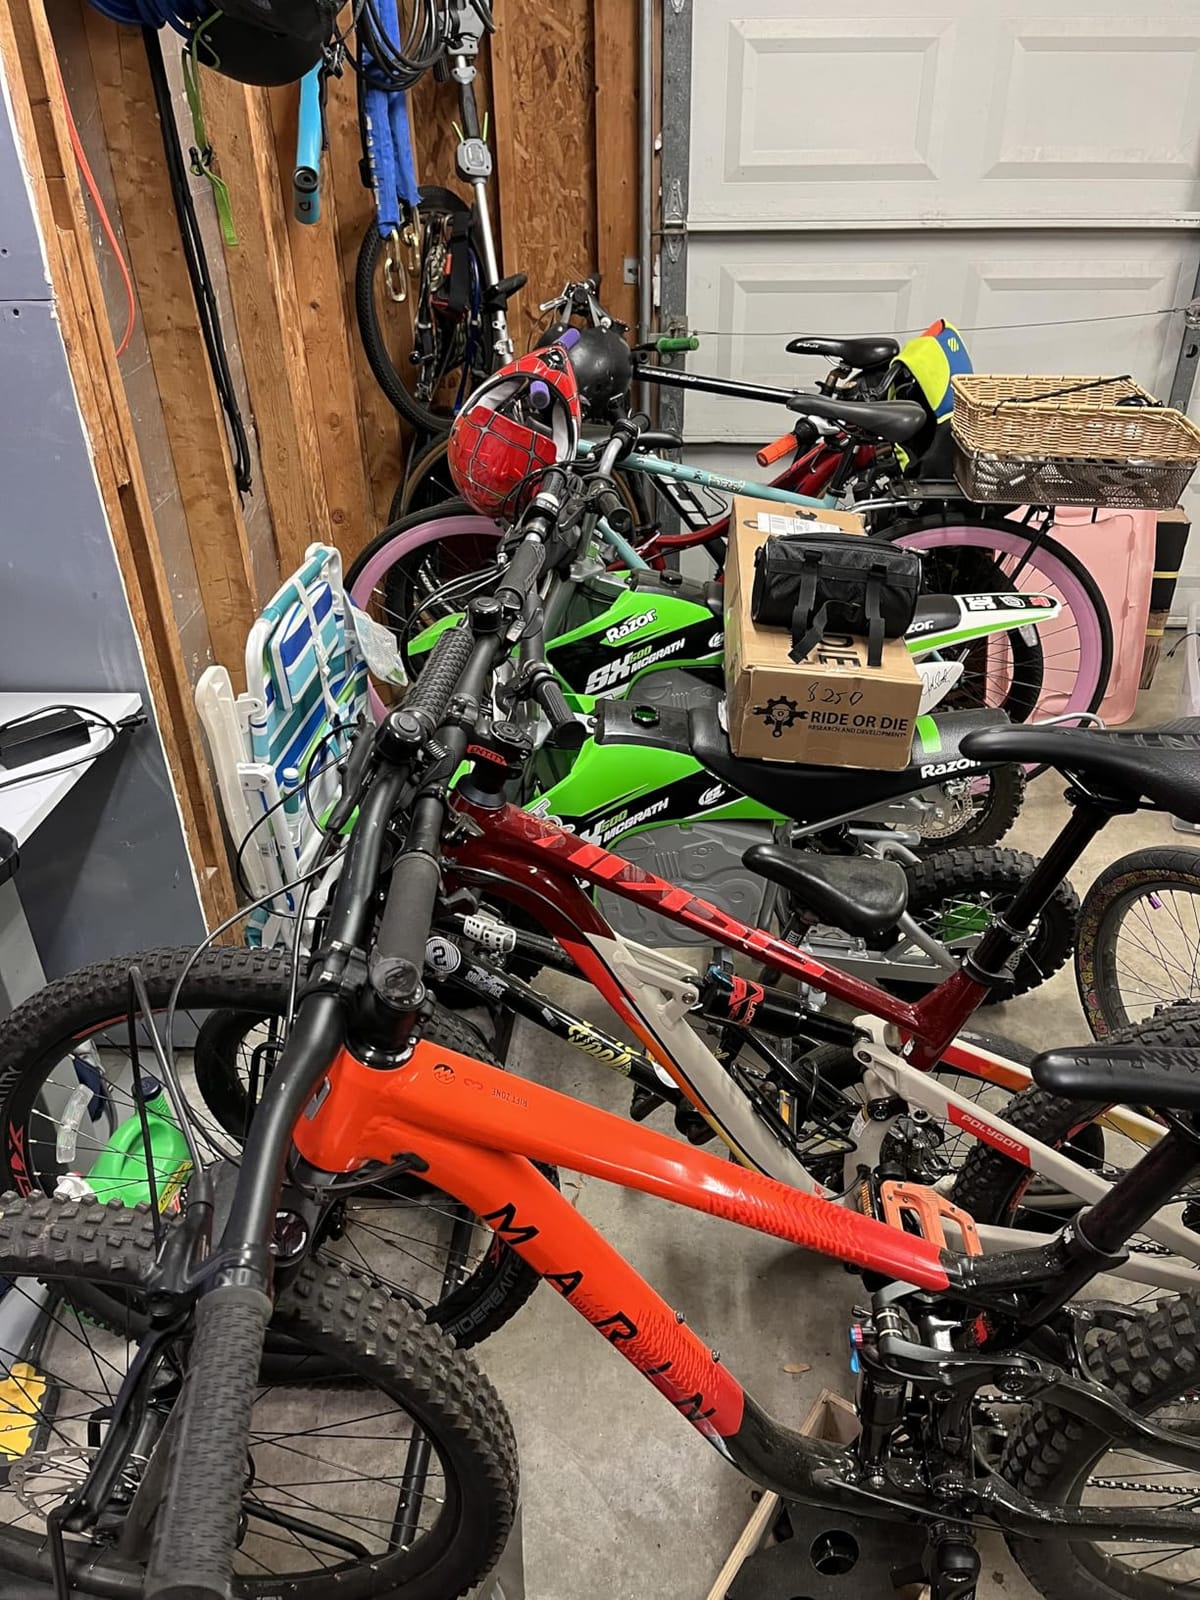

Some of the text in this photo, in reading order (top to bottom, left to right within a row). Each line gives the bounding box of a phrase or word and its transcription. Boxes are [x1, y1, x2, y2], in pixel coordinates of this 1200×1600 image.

[630, 637, 686, 674] MCGRATH
[808, 724, 841, 734] RESEARCH
[841, 727, 856, 735] AND
[810, 711, 909, 731] RIDE OR DIE
[603, 797, 669, 843] MCGRATH
[960, 1113, 1024, 1152] POLYGON
[483, 1202, 717, 1423] MARIN
